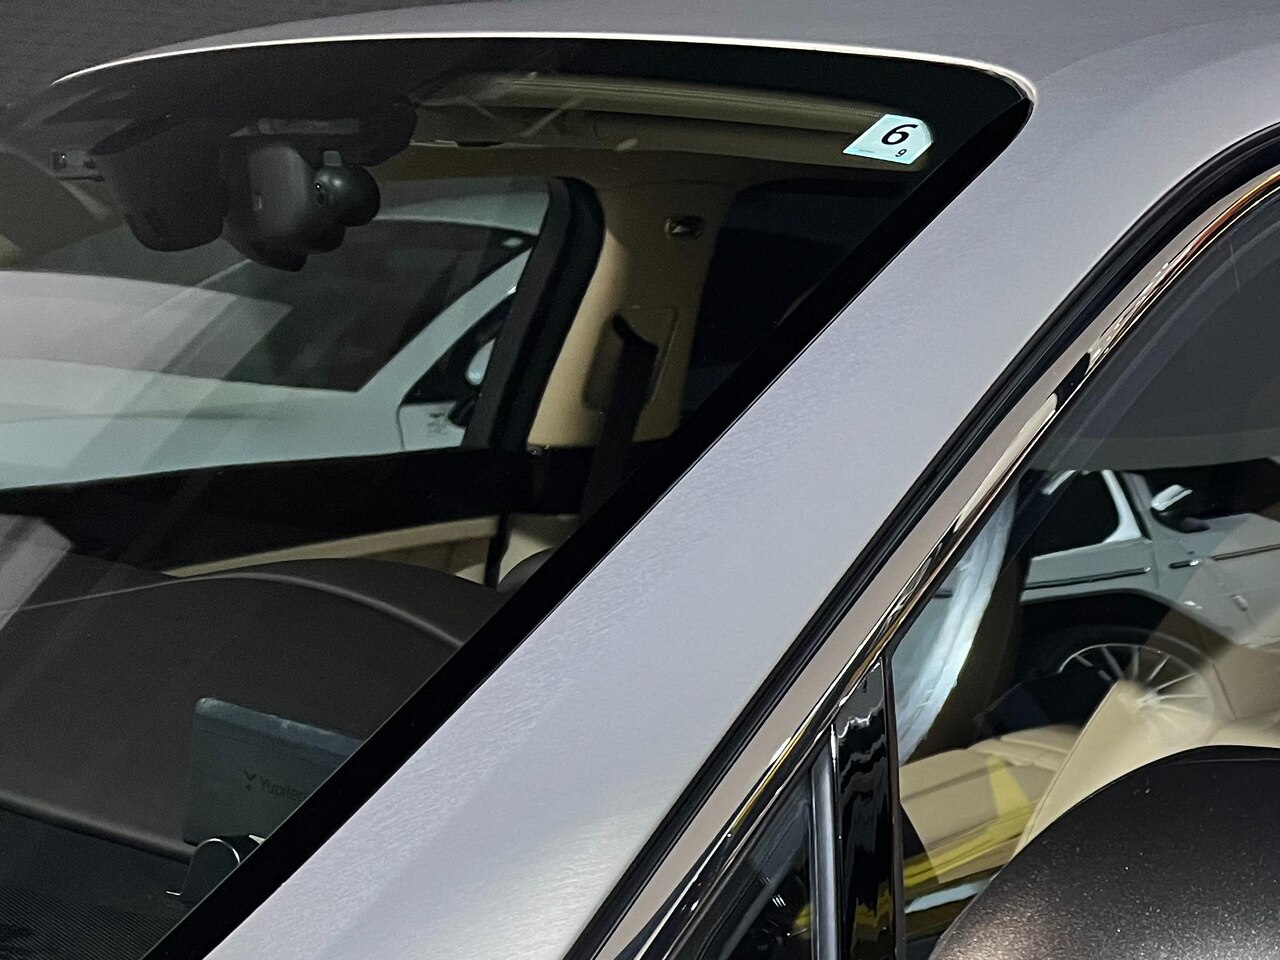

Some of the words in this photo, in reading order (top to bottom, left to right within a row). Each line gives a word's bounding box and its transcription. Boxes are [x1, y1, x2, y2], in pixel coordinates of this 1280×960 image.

[881, 124, 919, 146] 6
[895, 149, 908, 158] 9
[259, 776, 307, 803] Yupiter
